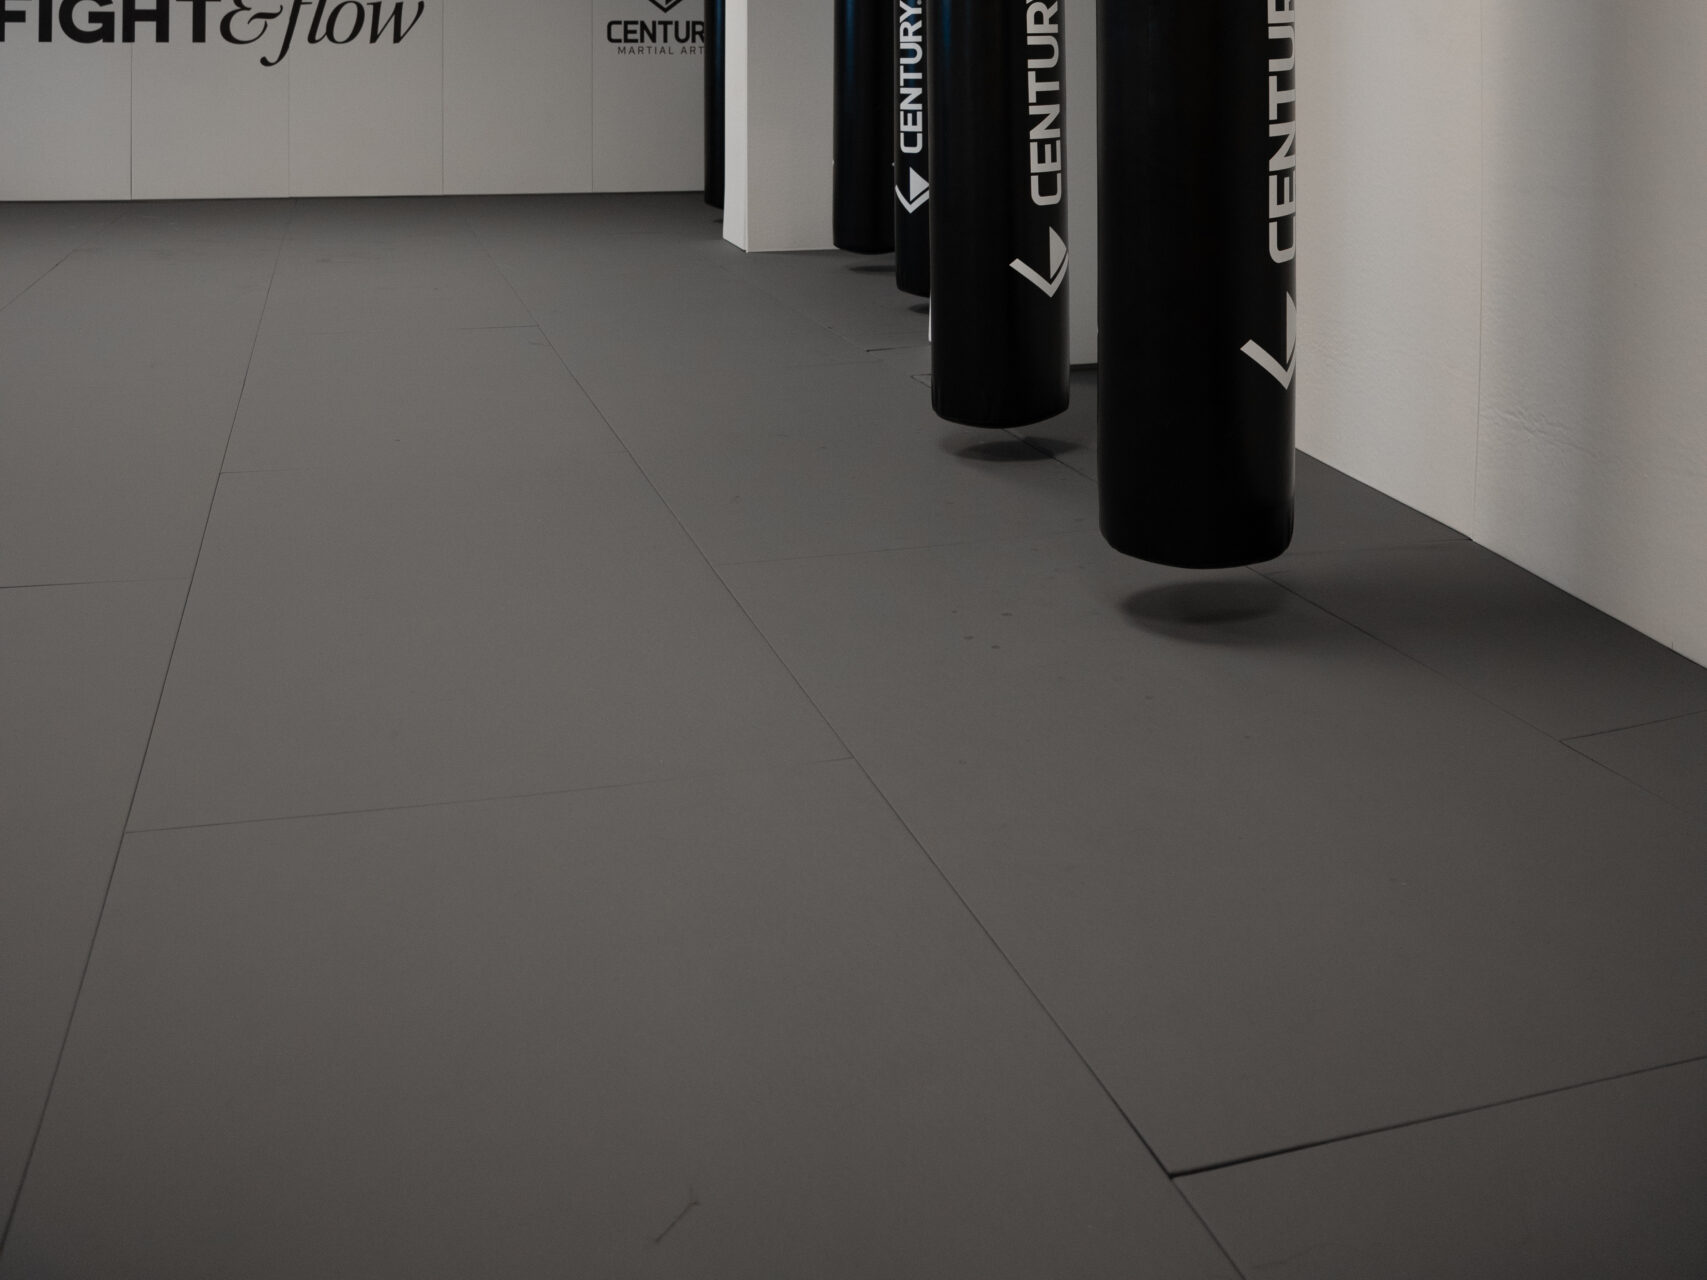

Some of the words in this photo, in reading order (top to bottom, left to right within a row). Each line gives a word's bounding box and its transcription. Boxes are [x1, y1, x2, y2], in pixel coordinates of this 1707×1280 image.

[606, 20, 705, 43] CENTUR
[617, 46, 674, 55] MARTIAL
[680, 46, 705, 55] ART
[899, 0, 923, 154] CENTURY
